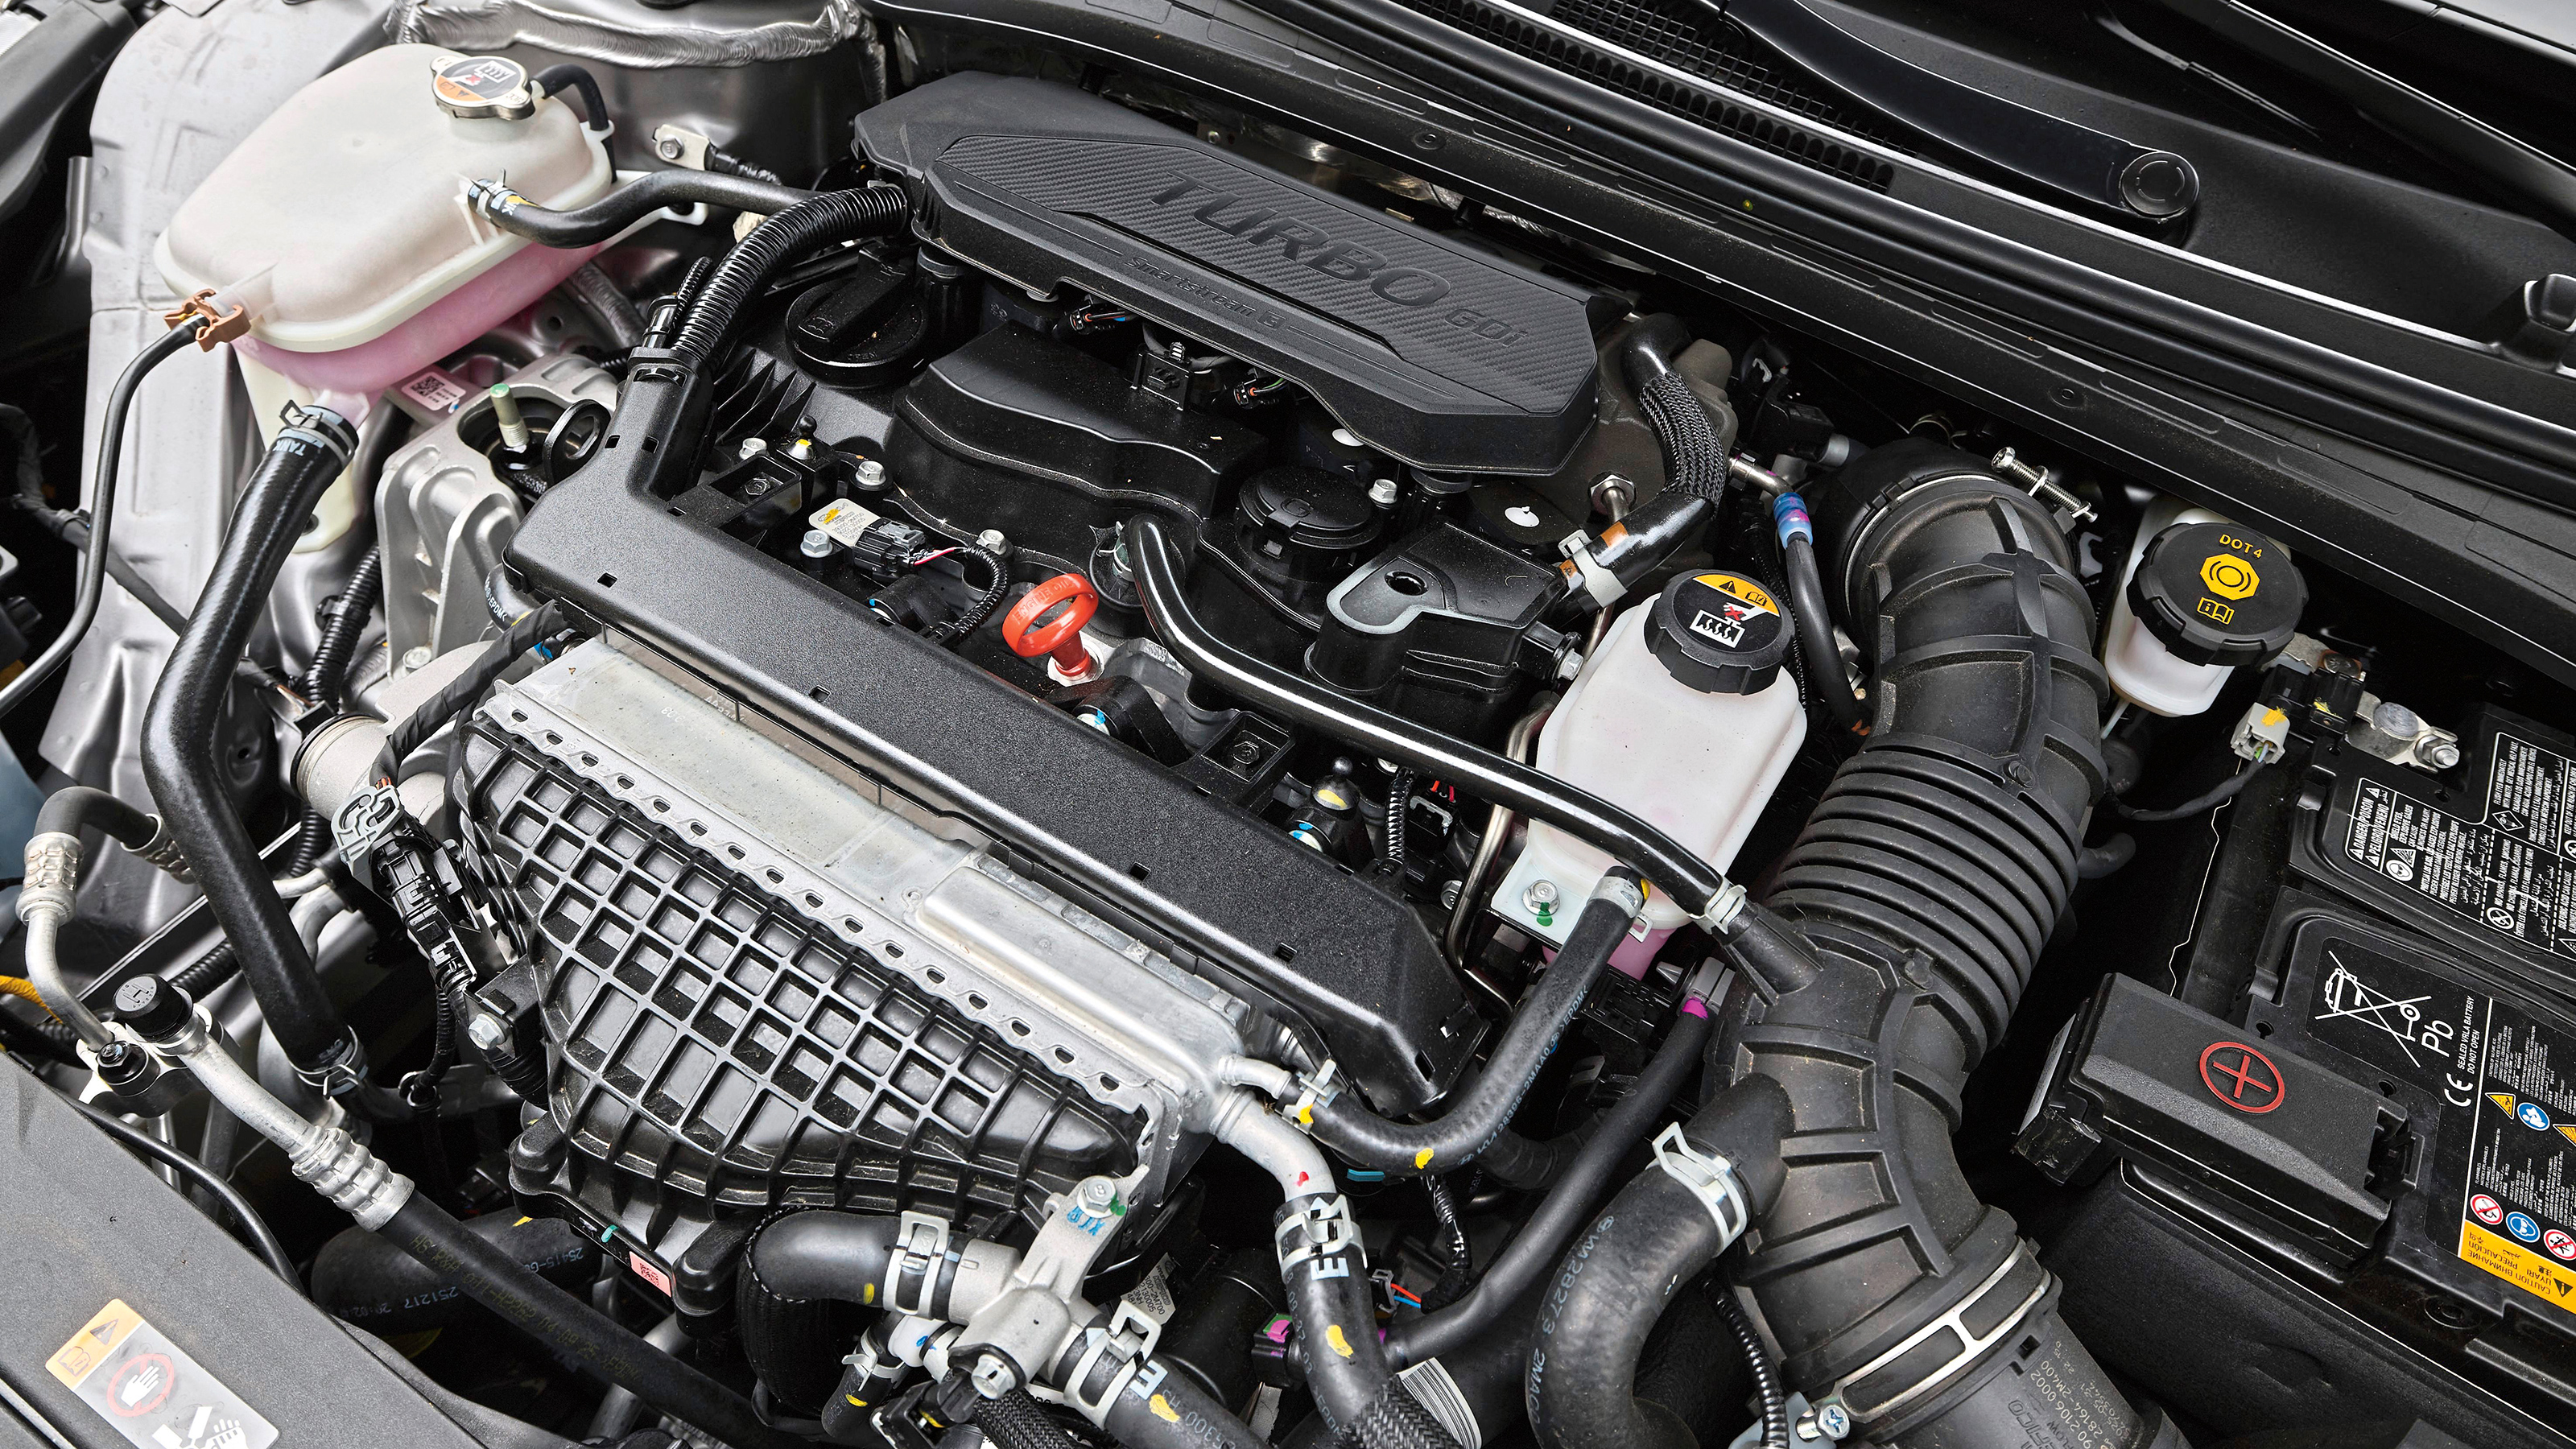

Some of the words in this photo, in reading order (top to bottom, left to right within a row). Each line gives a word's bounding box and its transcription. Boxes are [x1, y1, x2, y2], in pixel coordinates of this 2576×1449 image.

[1151, 170, 1451, 306] TURBO
[1126, 255, 1257, 316] Smartstream
[273, 439, 307, 456] TANK
[1013, 588, 1053, 625] ENGINE
[1054, 580, 1075, 591] OIL
[2495, 897, 2502, 907] NO
[2506, 902, 2514, 912] NO
[2464, 996, 2475, 1026] BATTERY
[2421, 1020, 2454, 1058] Pb
[2461, 1026, 2471, 1043] VRLA
[2471, 1030, 2480, 1049] OPEN
[2458, 1043, 2467, 1070] SEALED
[2467, 1063, 2475, 1075] DO
[2468, 1051, 2479, 1063] NOT
[1498, 1046, 1550, 1133] 28396-2MAA0
[2444, 1072, 2474, 1107] CE
[2468, 1249, 2512, 1277] ВНИМАНИЕ
[2515, 1273, 2551, 1294] CAUTION
[404, 1286, 459, 1309] 251217
[2041, 1360, 2103, 1439] 28164-2M400
